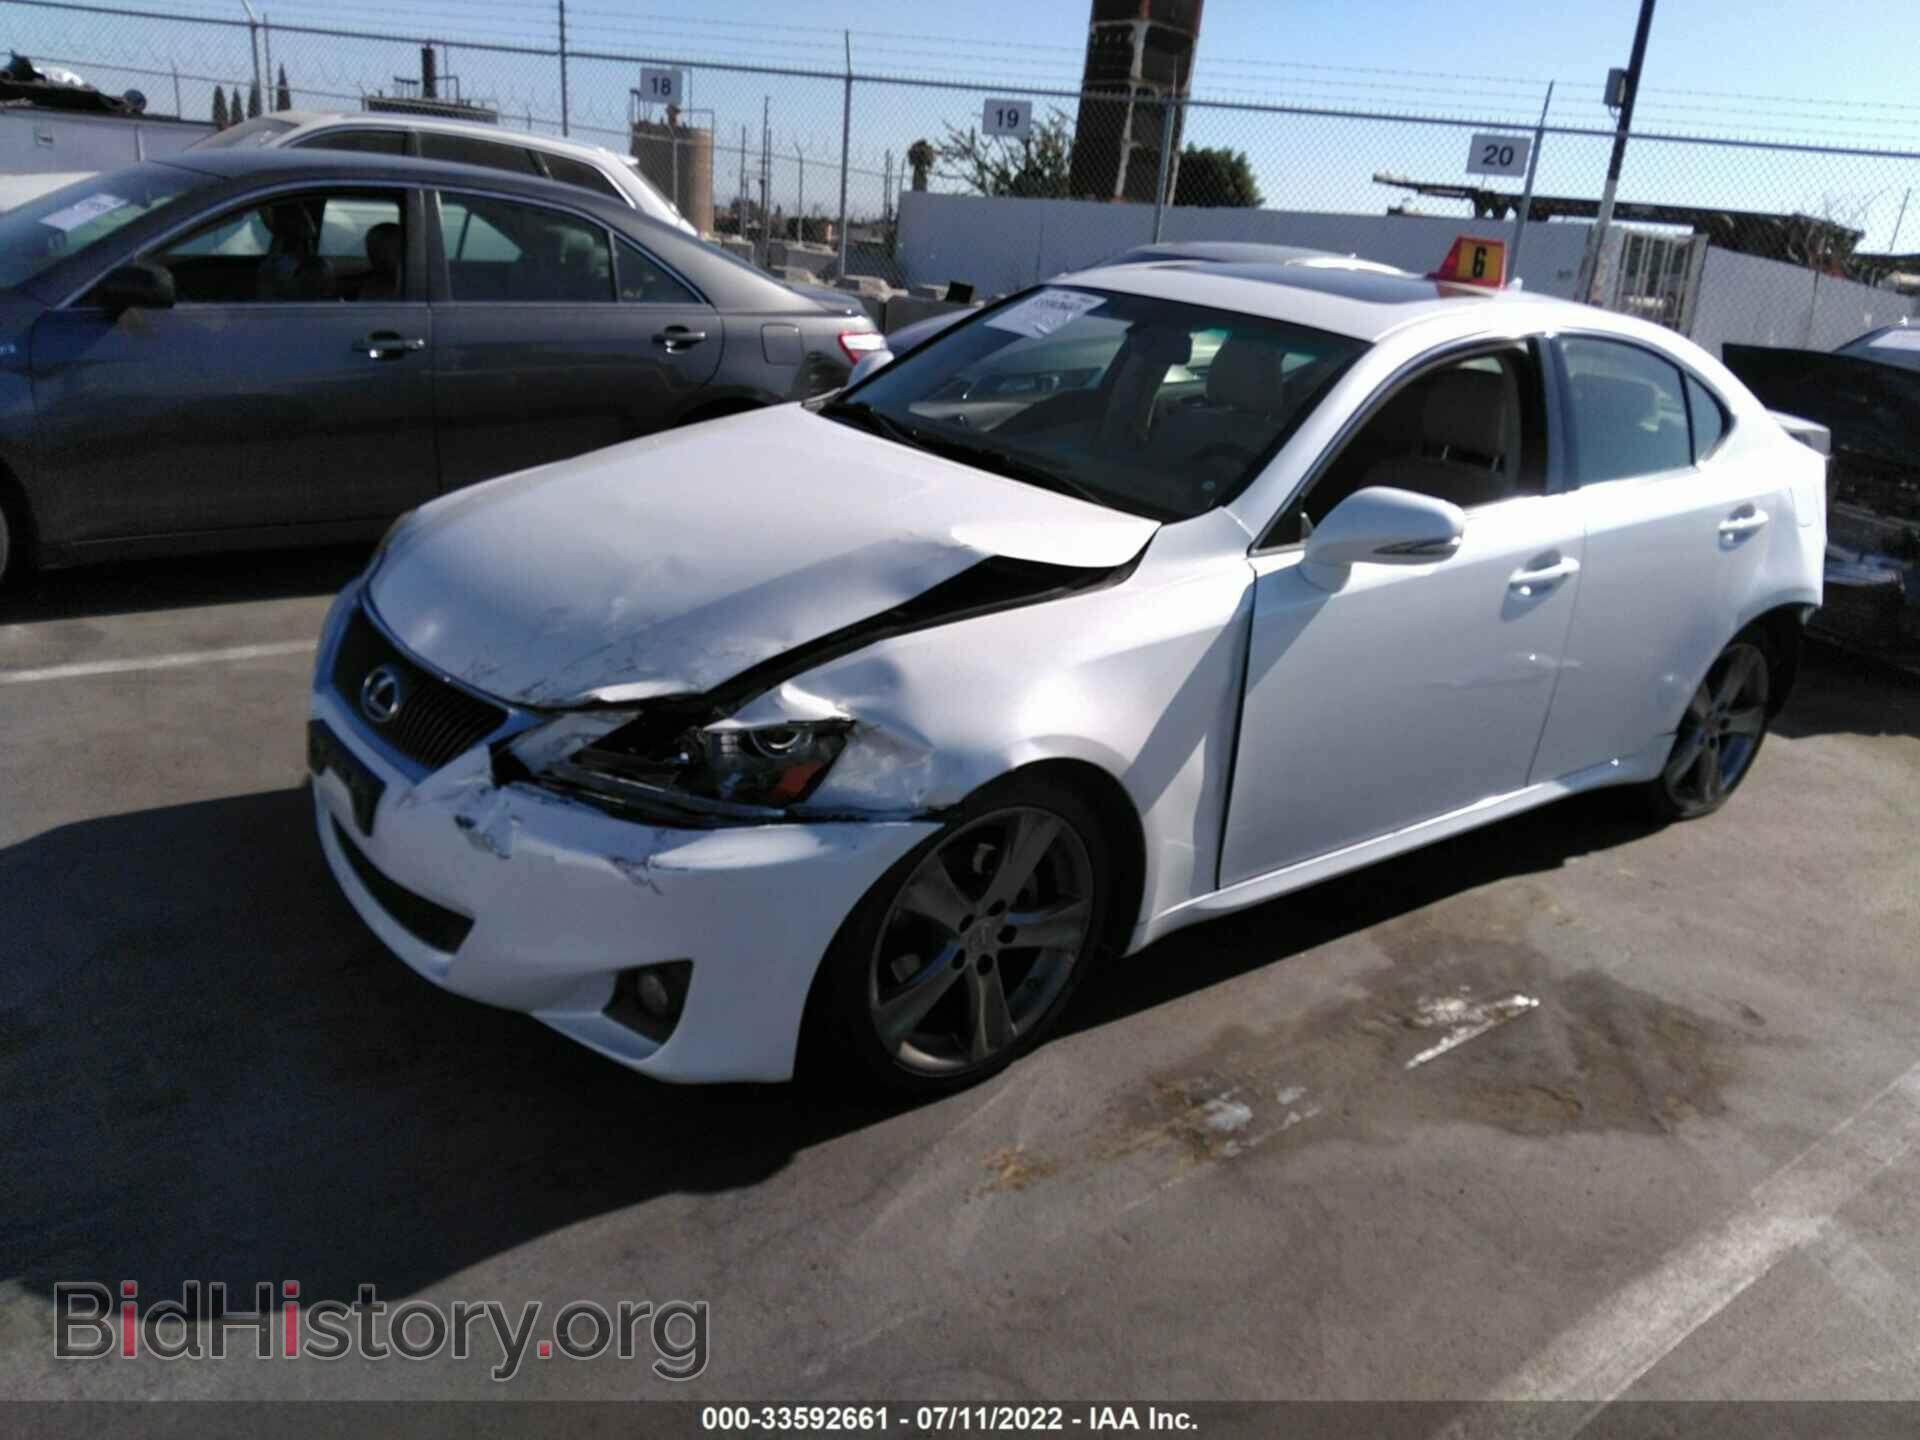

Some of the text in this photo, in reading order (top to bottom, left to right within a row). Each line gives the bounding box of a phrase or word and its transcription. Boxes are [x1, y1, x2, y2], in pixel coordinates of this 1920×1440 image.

[651, 77, 672, 96] 18
[995, 108, 1019, 129] 19
[1482, 144, 1514, 167] 20
[1473, 246, 1487, 278] 6
